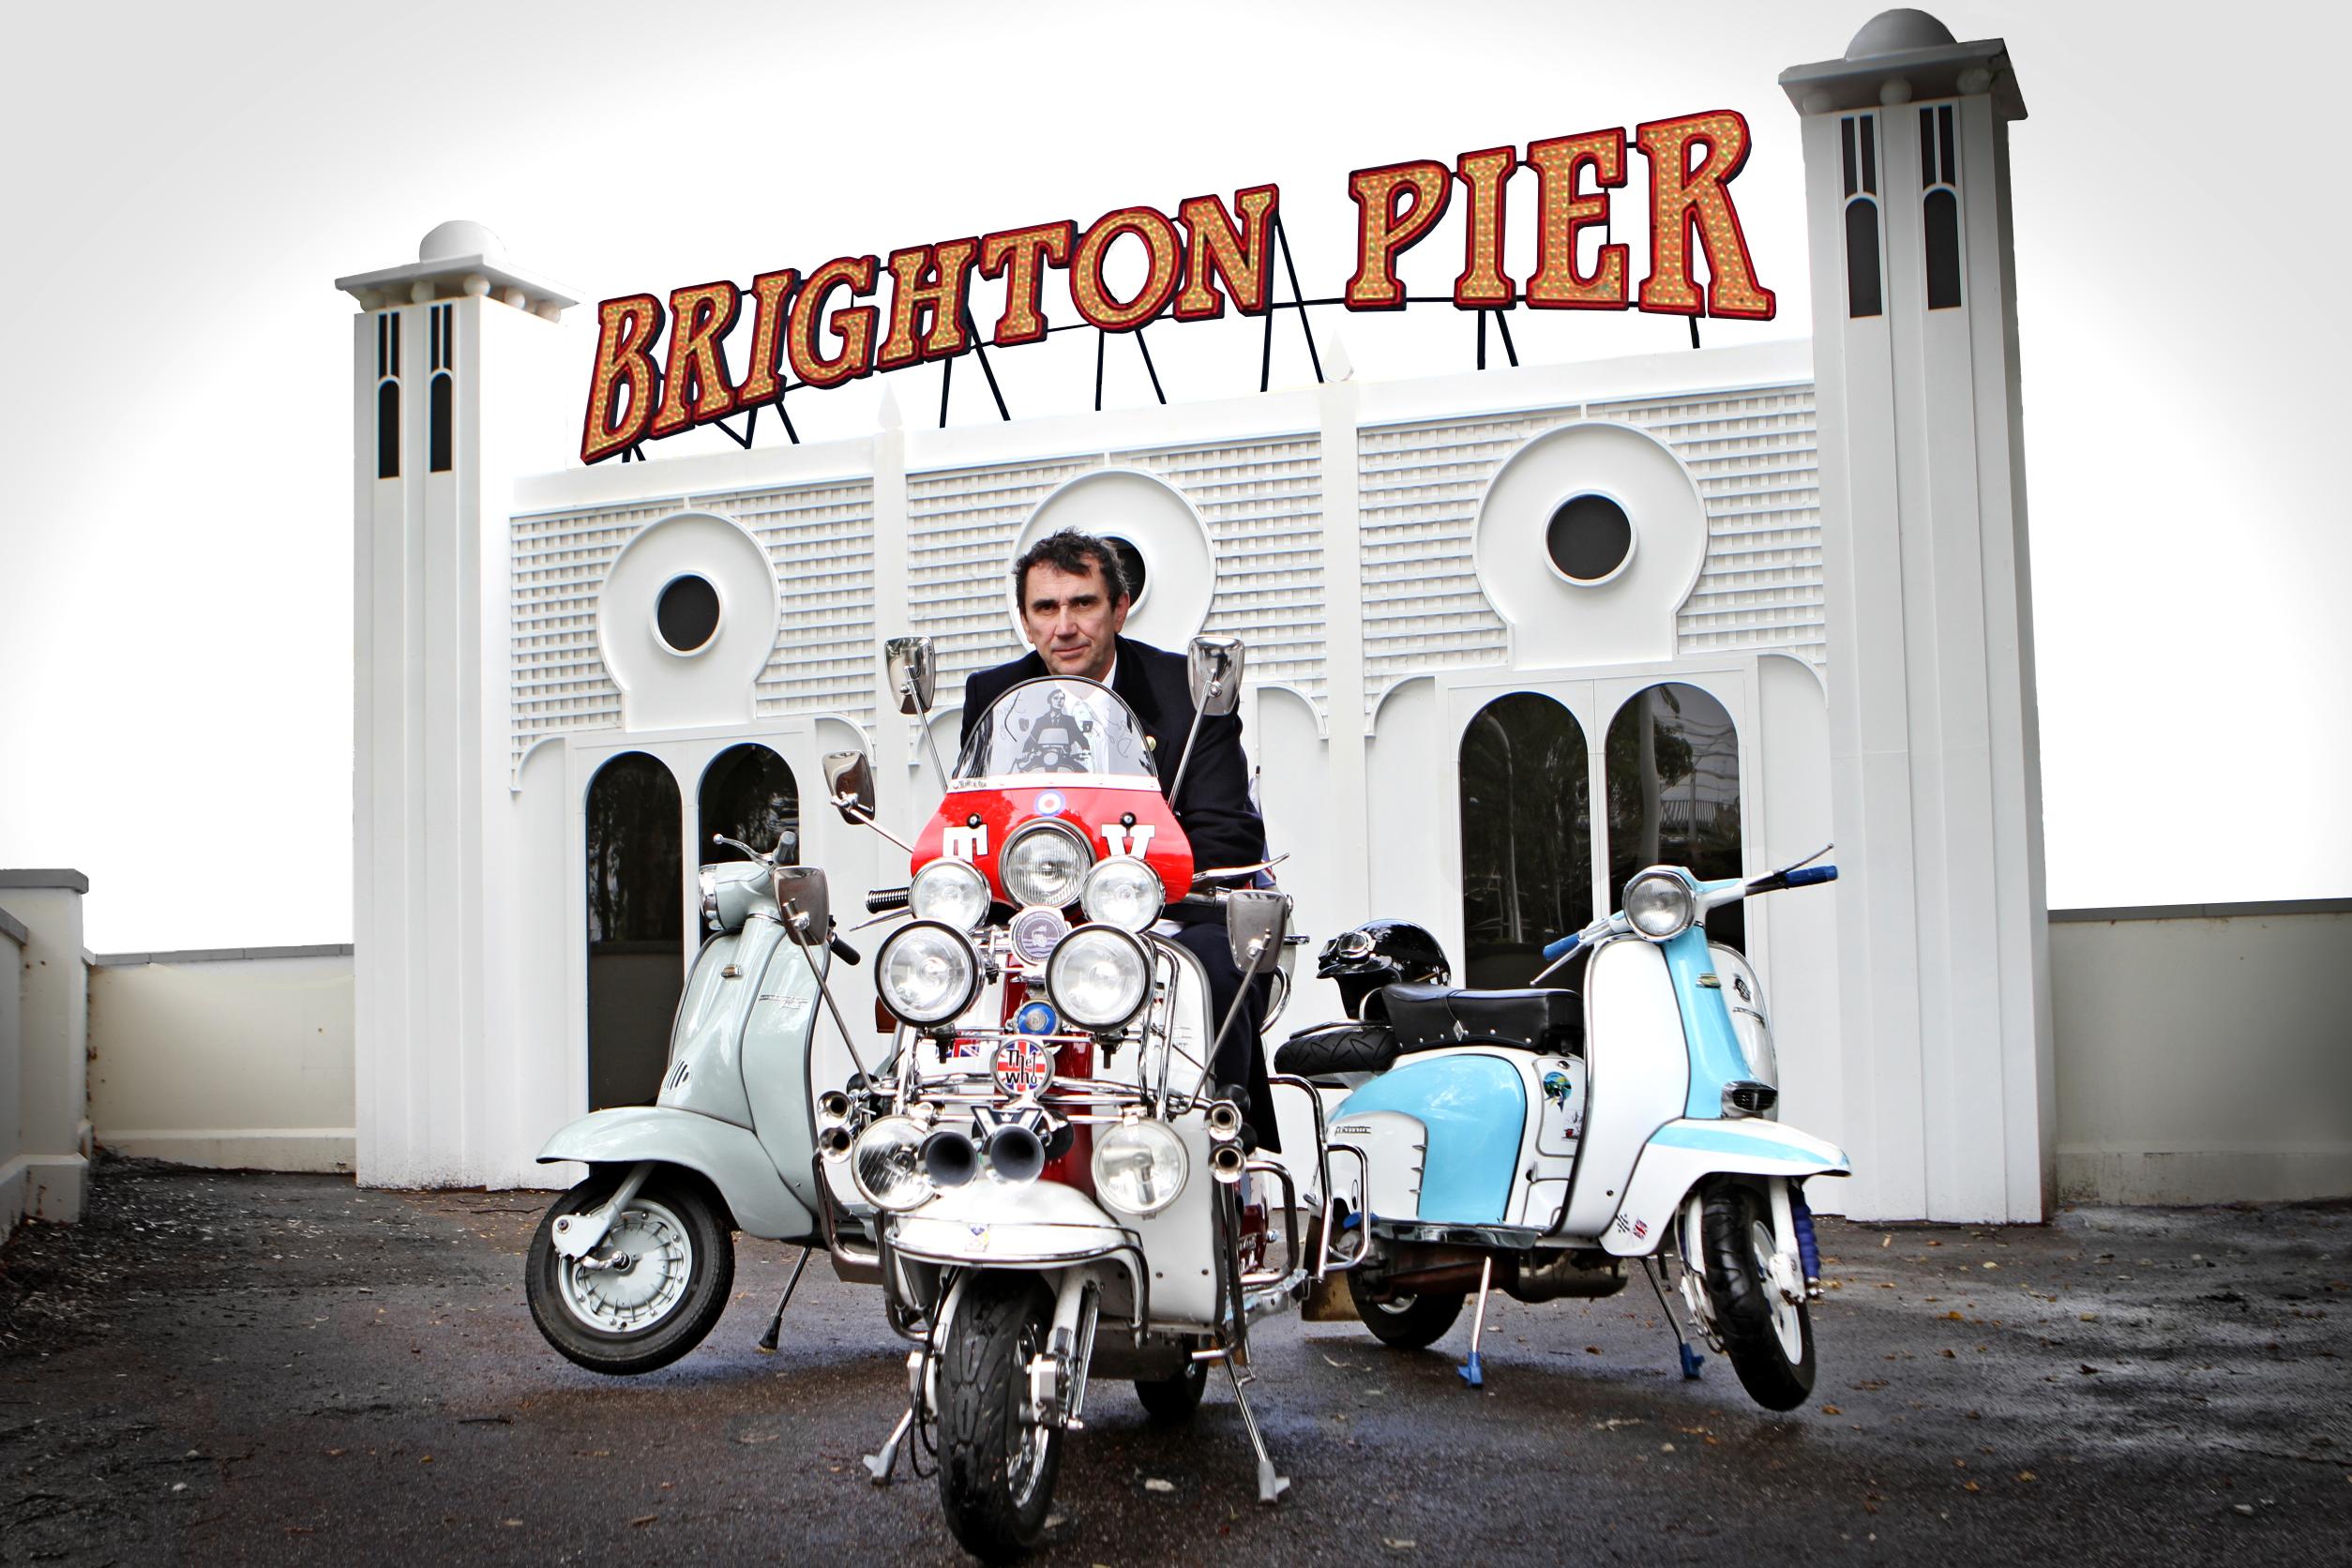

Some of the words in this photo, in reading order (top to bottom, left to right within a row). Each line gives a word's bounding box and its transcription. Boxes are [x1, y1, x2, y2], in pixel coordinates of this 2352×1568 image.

[580, 185, 1280, 463] BRIGHTON
[1345, 109, 1776, 320] PIER
[1006, 1049, 1033, 1068] The
